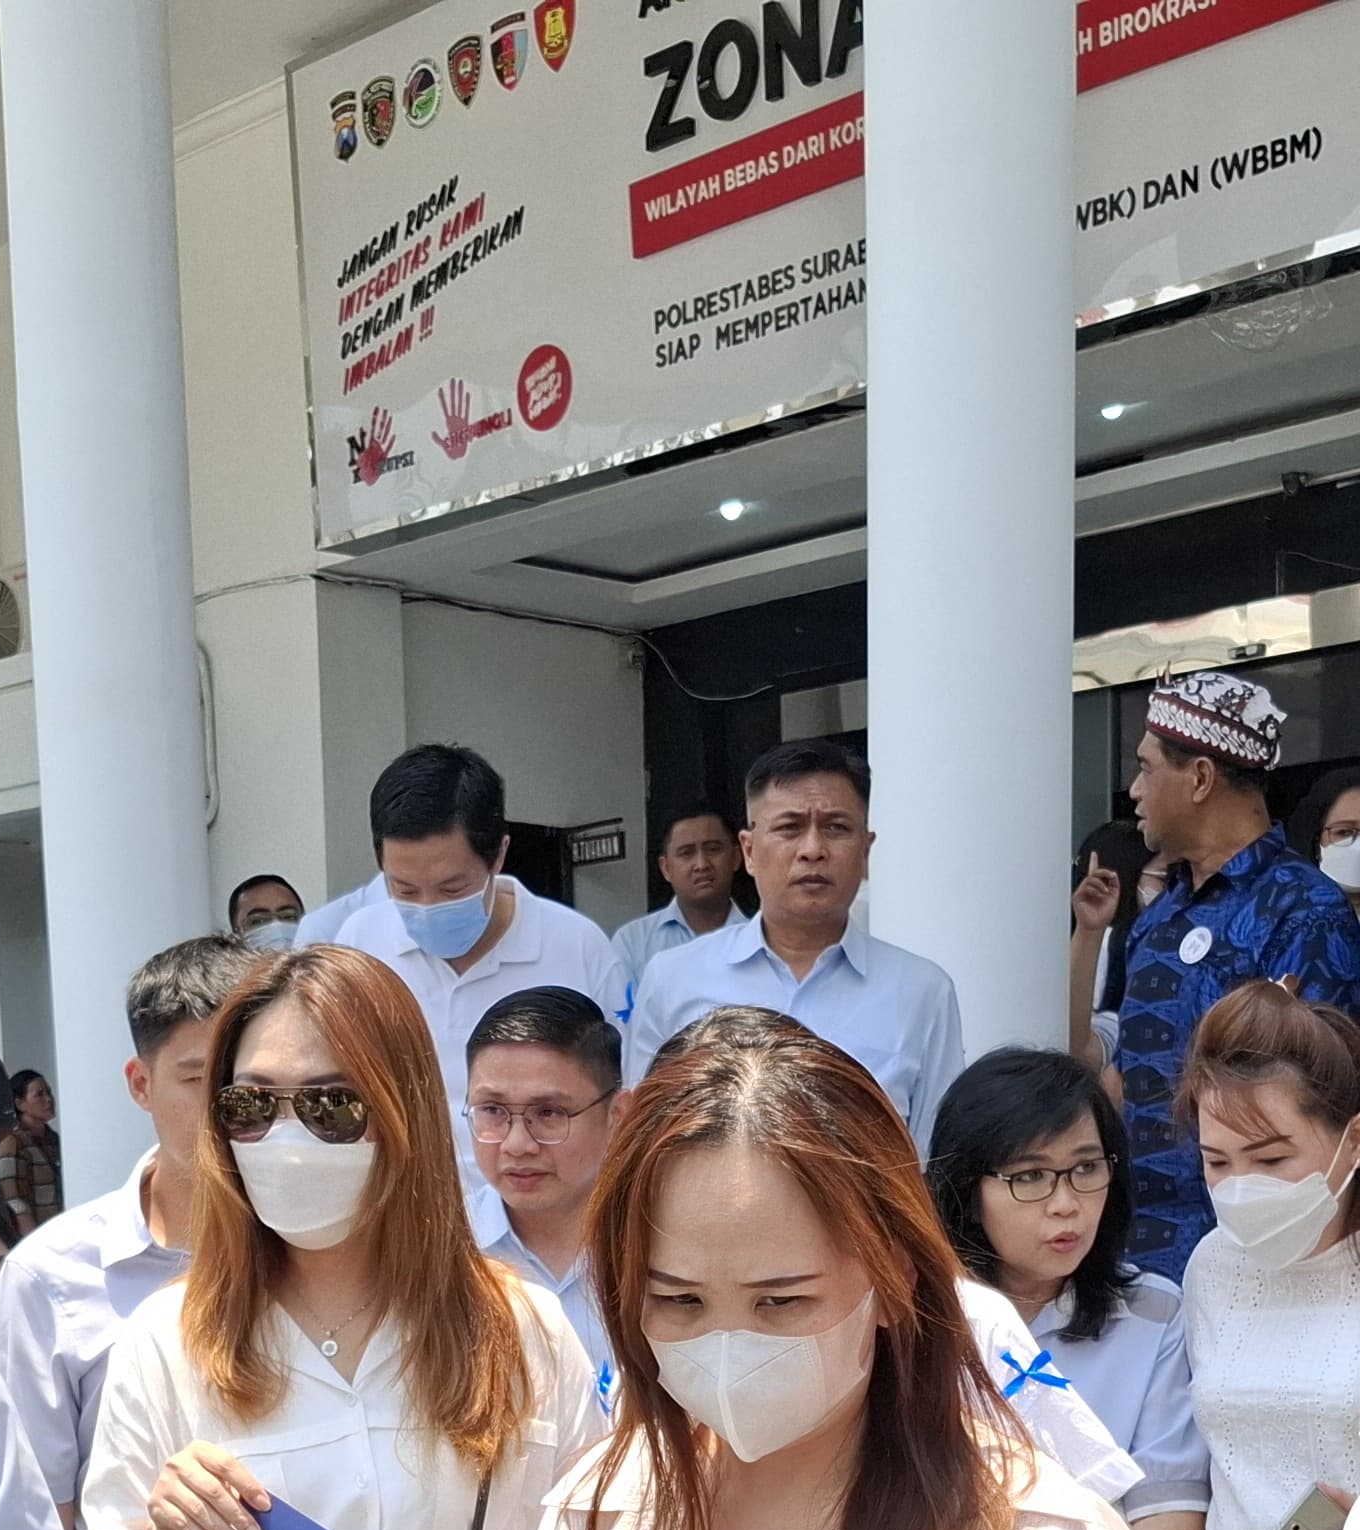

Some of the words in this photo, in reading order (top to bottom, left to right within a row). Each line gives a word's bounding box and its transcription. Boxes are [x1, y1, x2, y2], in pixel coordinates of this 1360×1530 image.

[644, 0, 863, 152] ZONA
[644, 174, 721, 223] WILAYAH
[724, 151, 778, 192] BEBAS
[783, 133, 824, 168] DARI
[1099, 0, 1217, 47] BIROKRA
[337, 221, 399, 288] JANGAN
[404, 174, 458, 240] RUSAK
[338, 235, 432, 326] INTEGRITAS
[439, 192, 485, 251] KAMI
[341, 292, 405, 359] DENGAN
[410, 205, 525, 312] MEMBERIKAN
[654, 265, 795, 334] POLRESTABES
[655, 333, 700, 368] SIAP
[1144, 165, 1199, 209] DAN
[1211, 127, 1322, 190] (WBBM)
[343, 323, 414, 395] IMBALAN
[419, 304, 434, 342] !!!
